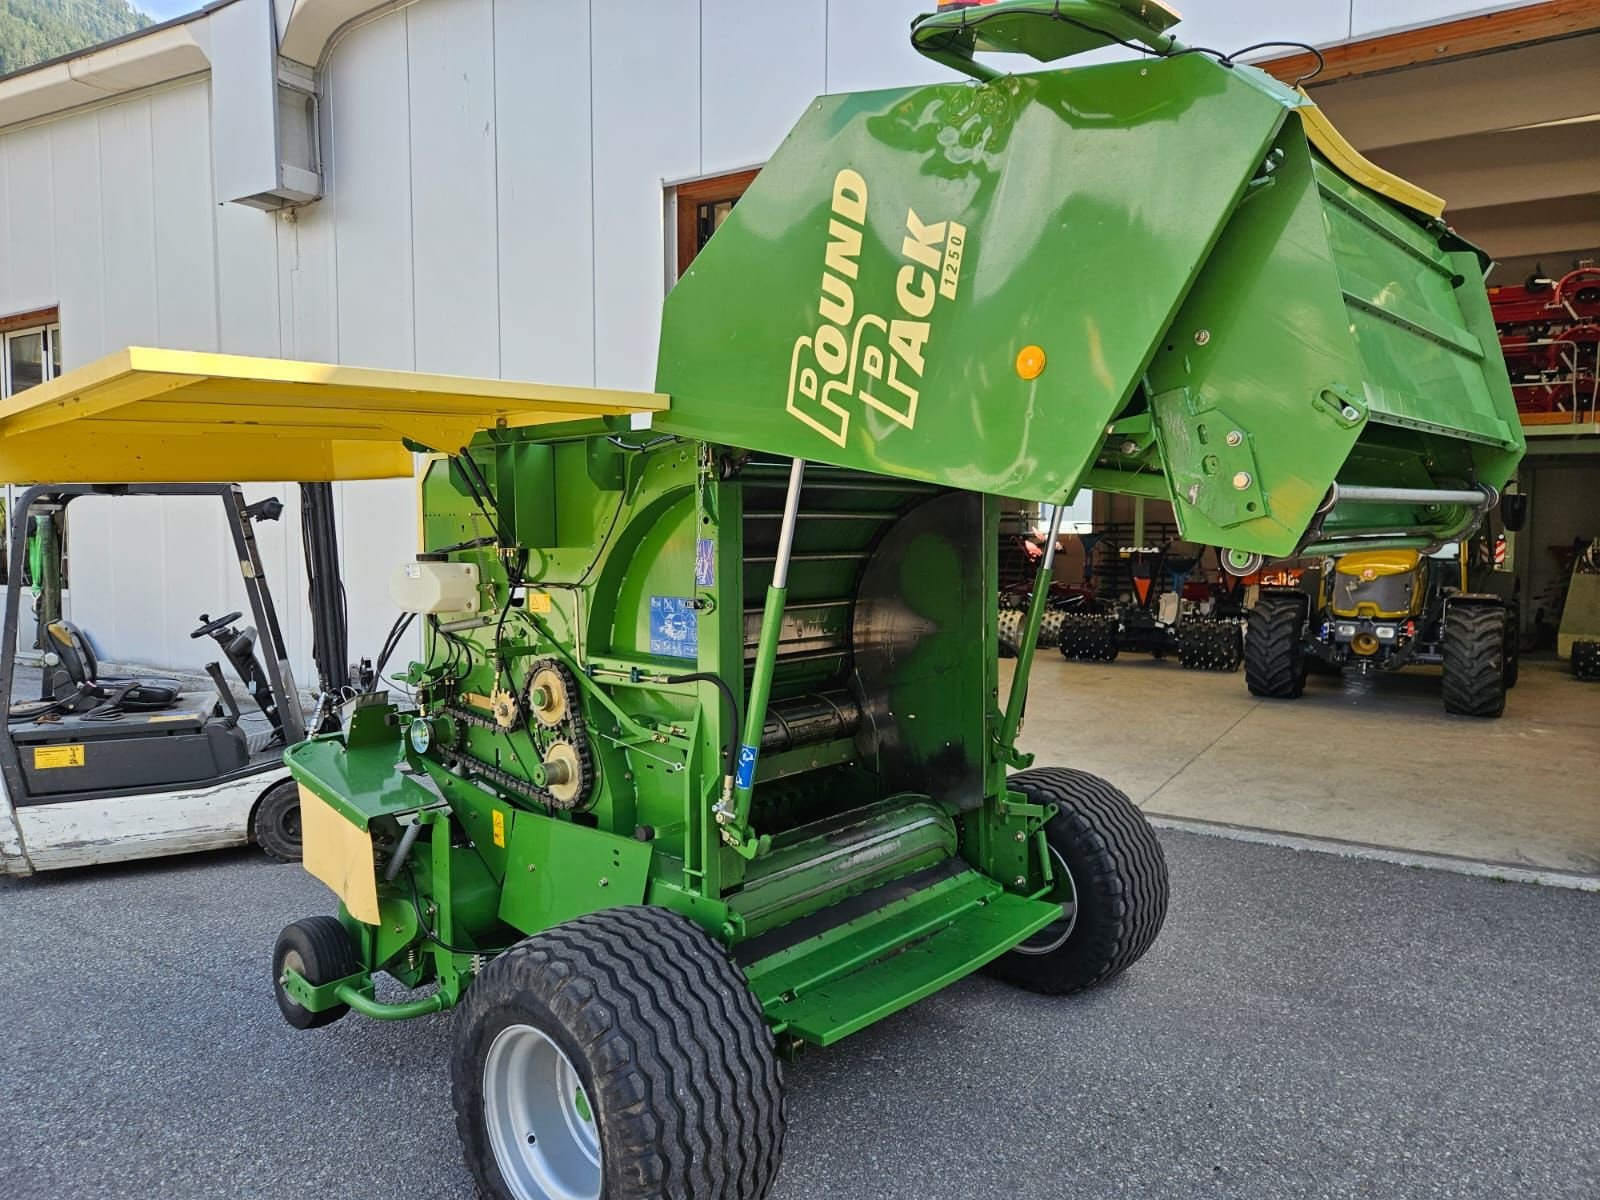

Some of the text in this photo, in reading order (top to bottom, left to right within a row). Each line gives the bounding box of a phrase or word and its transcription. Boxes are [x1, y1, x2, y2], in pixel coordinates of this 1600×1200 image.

[786, 169, 868, 448] ROUND
[849, 208, 947, 430] PACK
[944, 236, 962, 286] 1250
